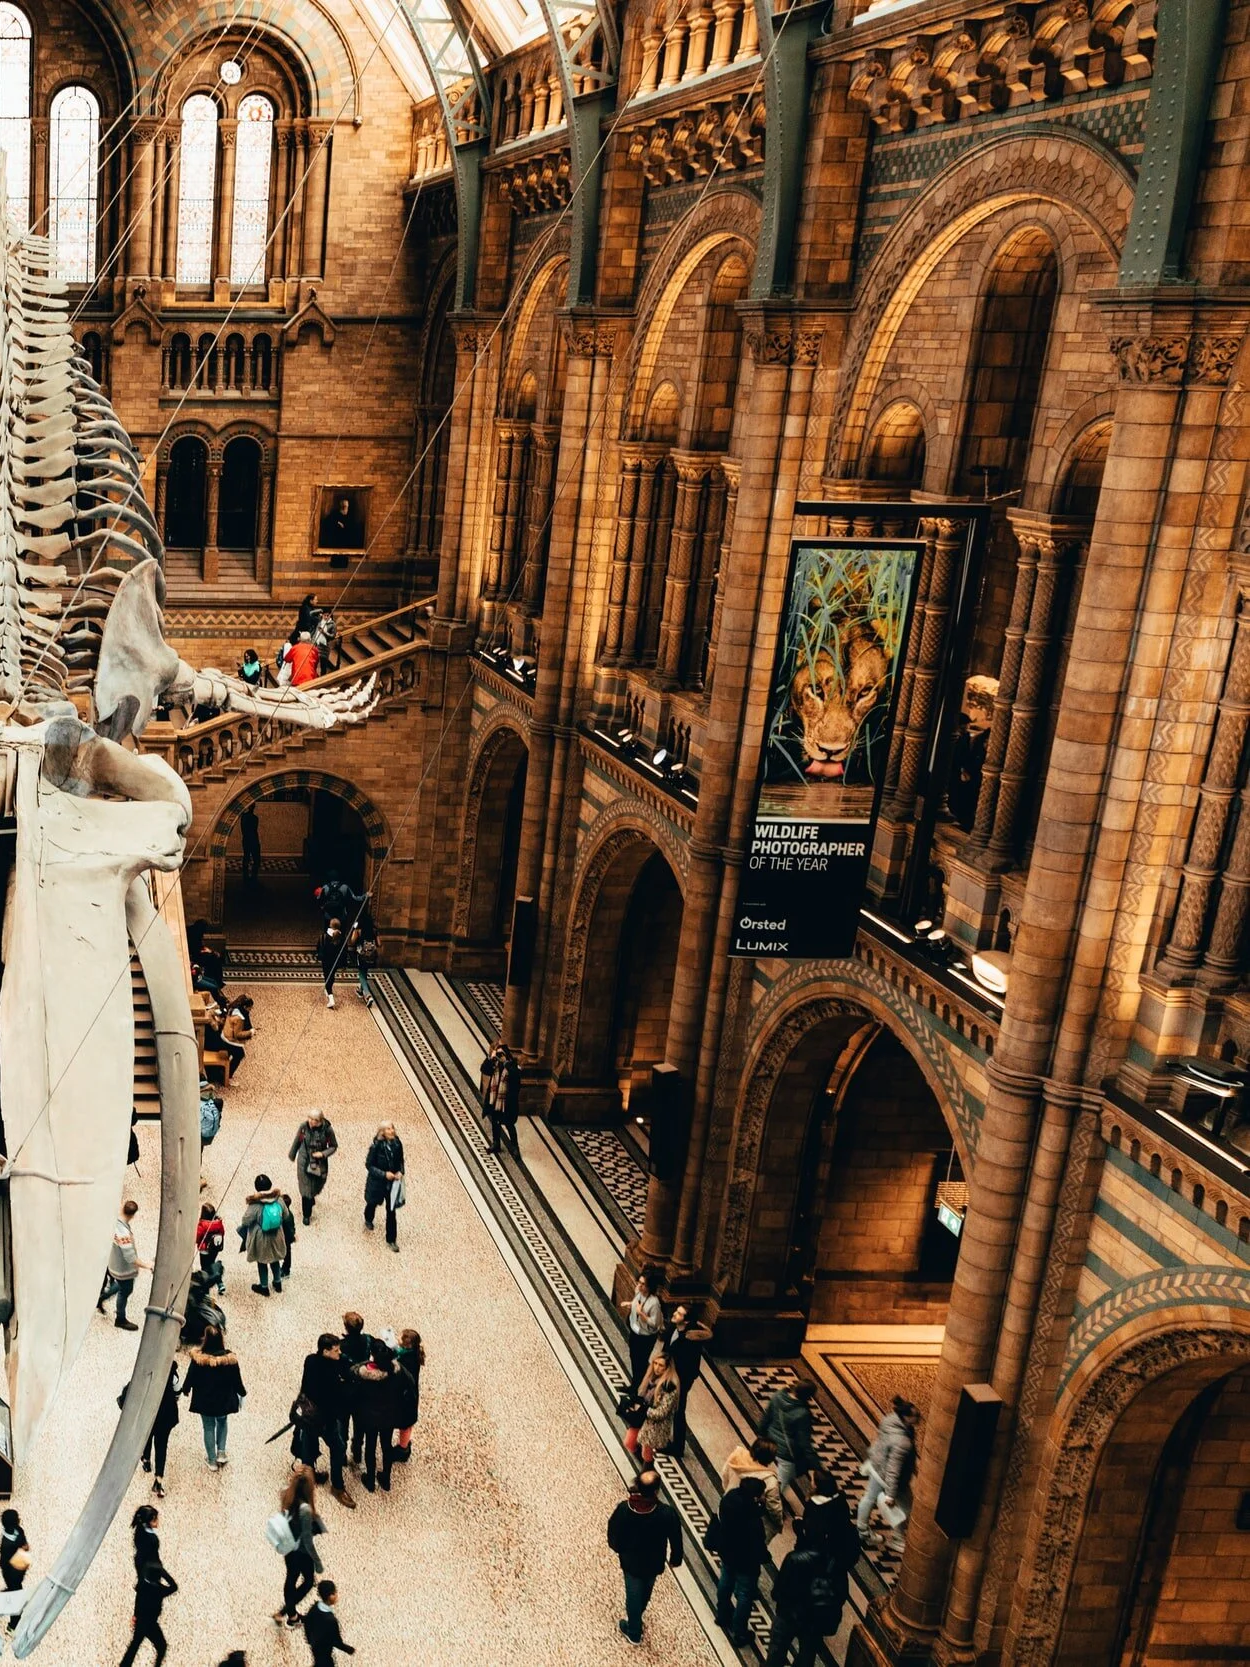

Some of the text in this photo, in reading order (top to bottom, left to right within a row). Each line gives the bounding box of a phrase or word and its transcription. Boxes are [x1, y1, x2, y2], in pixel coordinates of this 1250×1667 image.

[754, 824, 819, 840] WILDLIFE
[750, 840, 865, 856] PHOTOGRAPHER
[750, 856, 828, 871] OF THE YEAR
[736, 938, 788, 951] LUMIX
